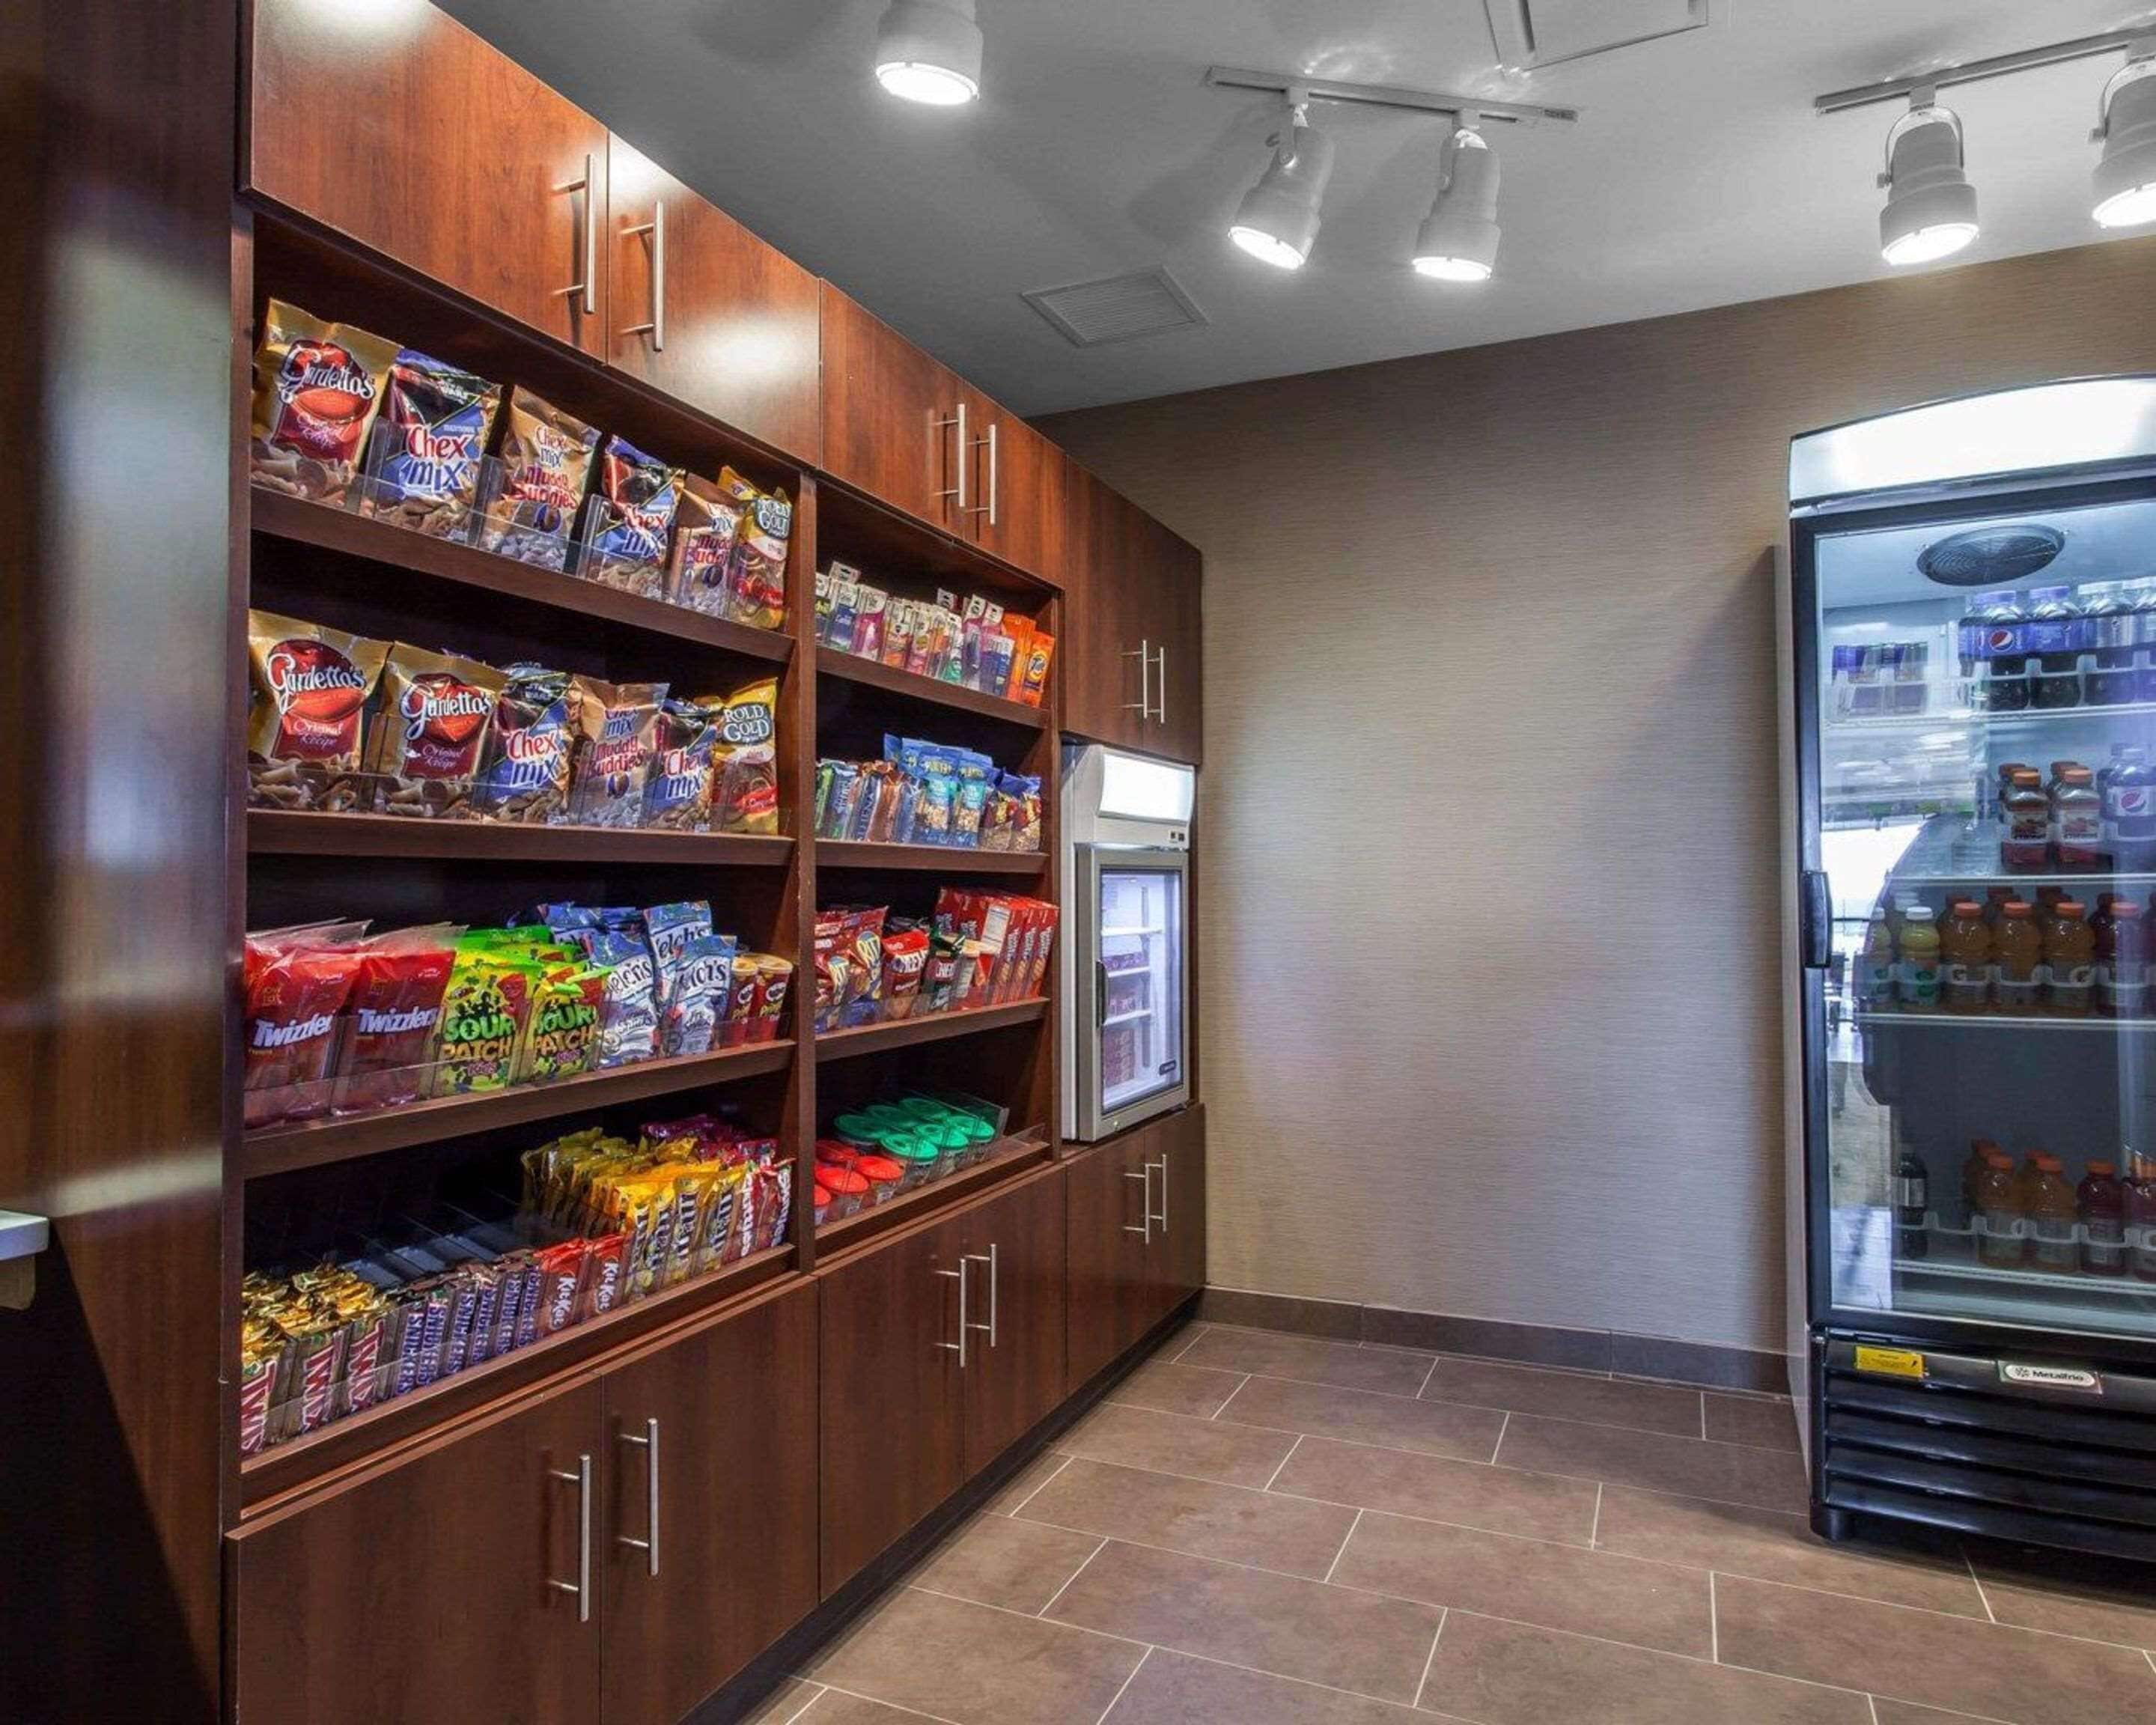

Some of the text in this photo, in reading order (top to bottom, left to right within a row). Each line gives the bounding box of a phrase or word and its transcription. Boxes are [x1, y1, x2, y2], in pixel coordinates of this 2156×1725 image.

[409, 425, 469, 458] Chex
[267, 652, 367, 715] Gardetto's
[401, 682, 492, 740] Gardetto's
[723, 704, 765, 723] ROLD
[509, 730, 558, 759] Chex
[723, 719, 770, 742] GOLD
[443, 1013, 514, 1042] SOUR
[417, 1303, 448, 1386] SNICKERS
[447, 1293, 475, 1374] SNICKERS
[396, 1312, 424, 1395] SNICKERS
[2032, 1369, 2085, 1382] Metalfrio
